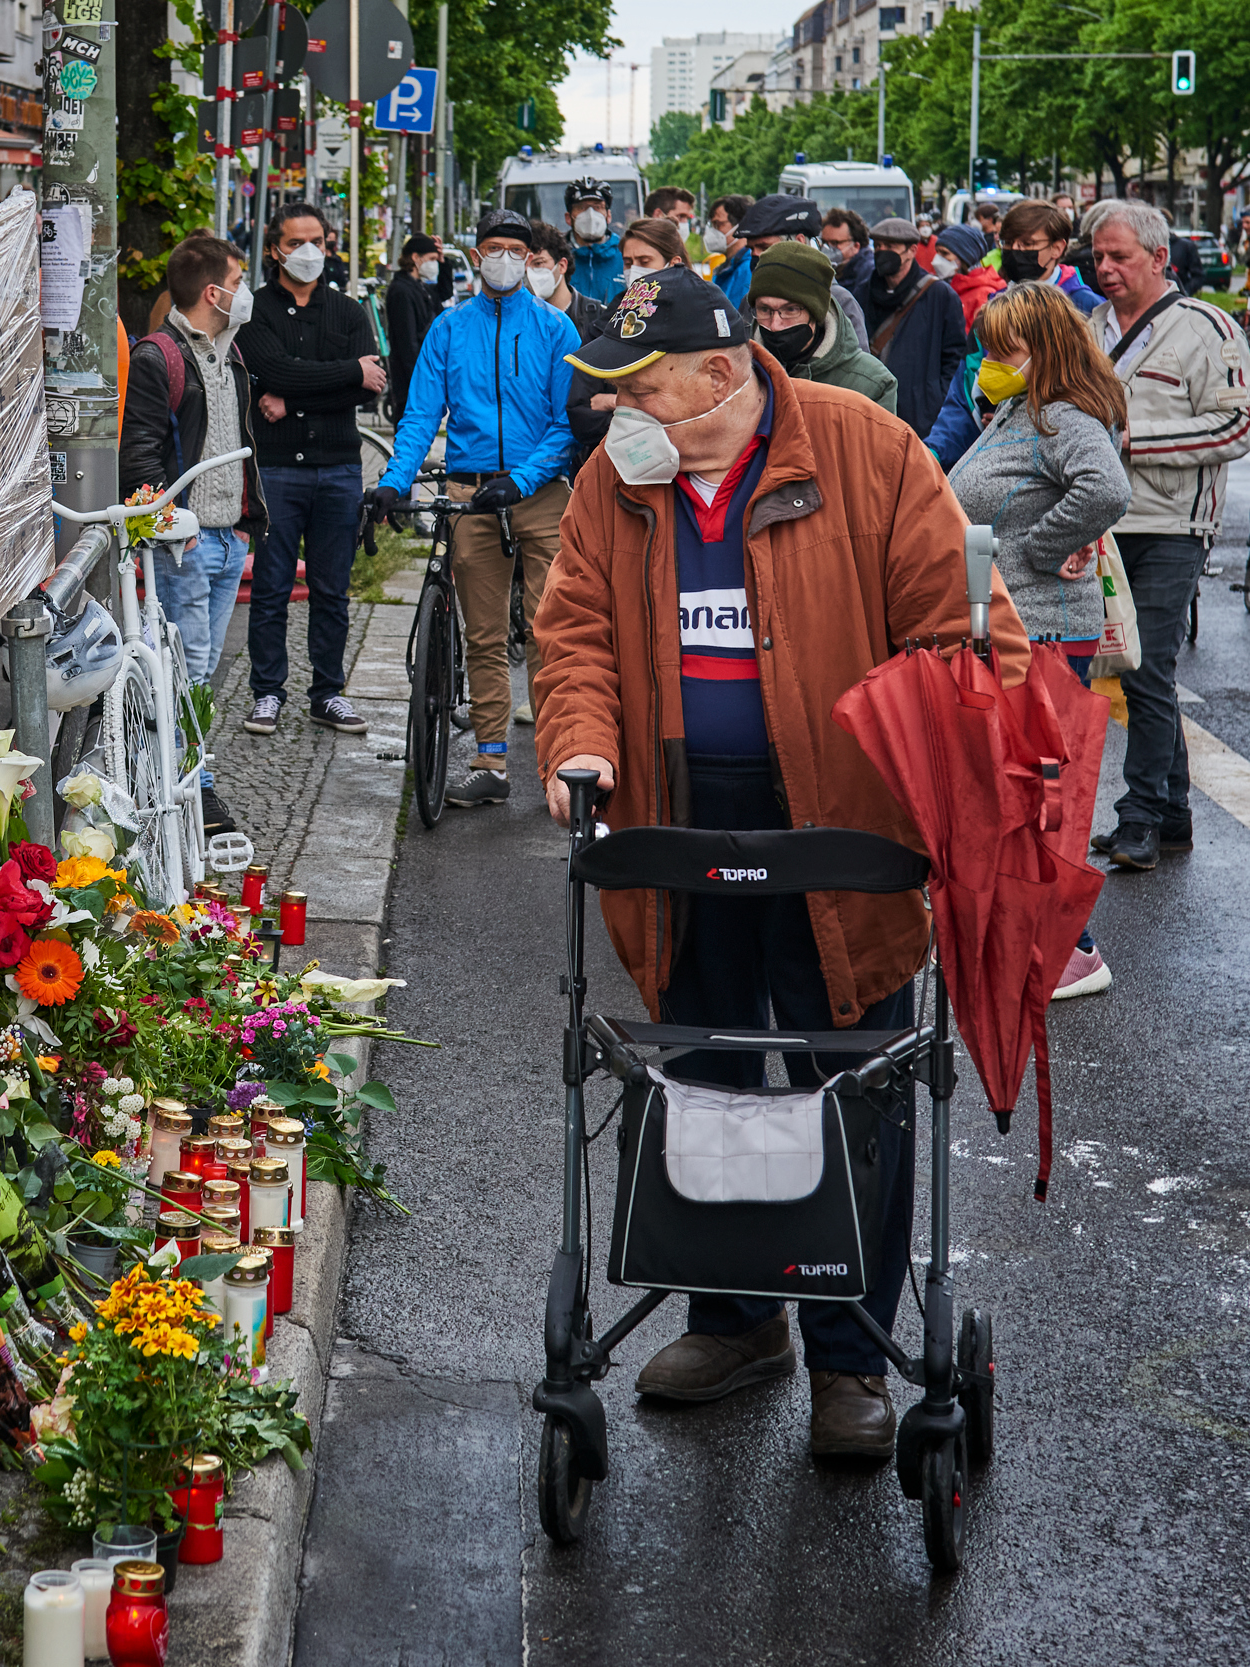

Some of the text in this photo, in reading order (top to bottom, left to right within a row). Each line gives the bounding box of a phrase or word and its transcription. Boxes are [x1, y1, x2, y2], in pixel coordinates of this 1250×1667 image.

[62, 37, 101, 59] MCH
[389, 76, 422, 122] P
[719, 868, 768, 881] TOPRO
[798, 1263, 848, 1276] TOPRO
